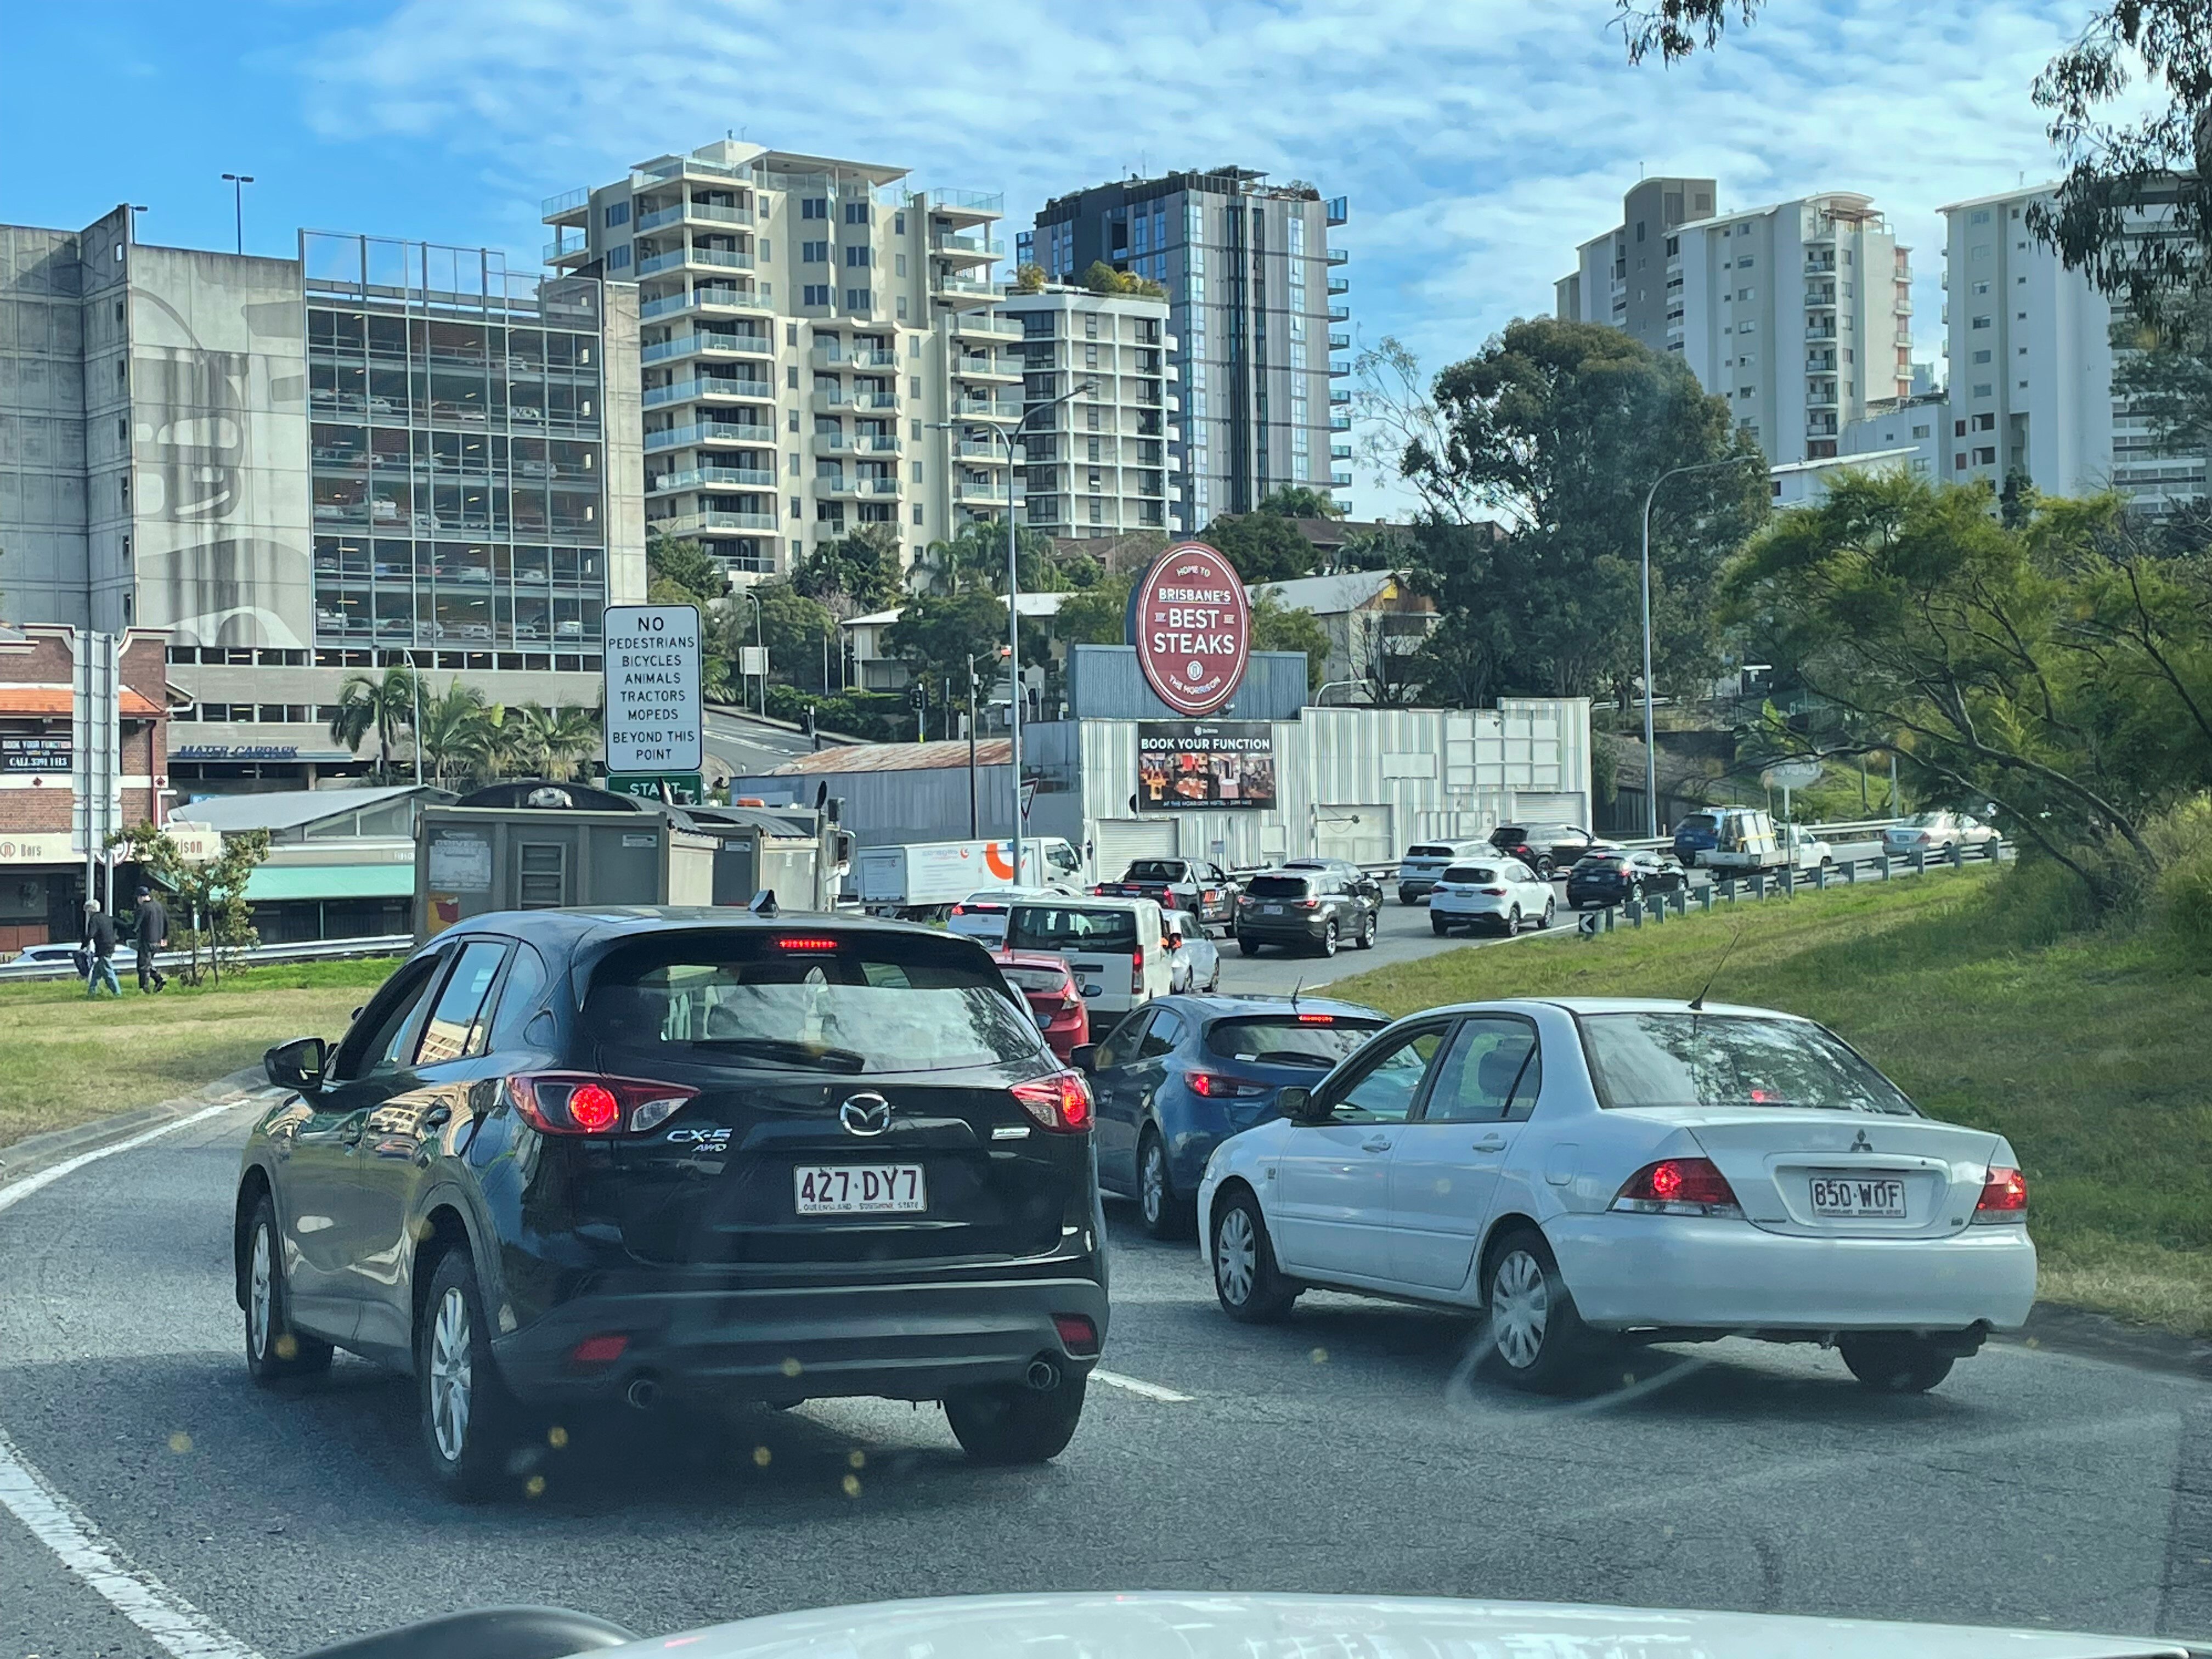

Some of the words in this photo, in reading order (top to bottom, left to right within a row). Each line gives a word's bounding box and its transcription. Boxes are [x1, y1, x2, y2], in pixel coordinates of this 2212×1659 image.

[1176, 565, 1199, 577] HOME
[1200, 566, 1211, 578] TO
[1159, 588, 1231, 602] BRISBANE'S
[638, 617, 664, 631] NO
[1169, 607, 1220, 629] BEST
[608, 636, 695, 650] PEDESTRIANS
[1153, 632, 1235, 654] STEAKS
[622, 654, 682, 668] BICYCLES
[624, 672, 681, 685] ANIMALS
[1169, 674, 1183, 691] THE
[620, 690, 686, 703] TRACTORS
[628, 708, 679, 720] MOPEDS
[613, 731, 663, 743] BEYOND
[667, 730, 695, 743] THIS
[1141, 738, 1175, 750] BOOK
[1178, 738, 1210, 750] YOUR
[1212, 738, 1270, 750] FUNCTION
[636, 748, 672, 760] POINT
[21, 844, 42, 857] Bars
[666, 1128, 733, 1143] CX-5
[691, 1143, 727, 1152] AWD
